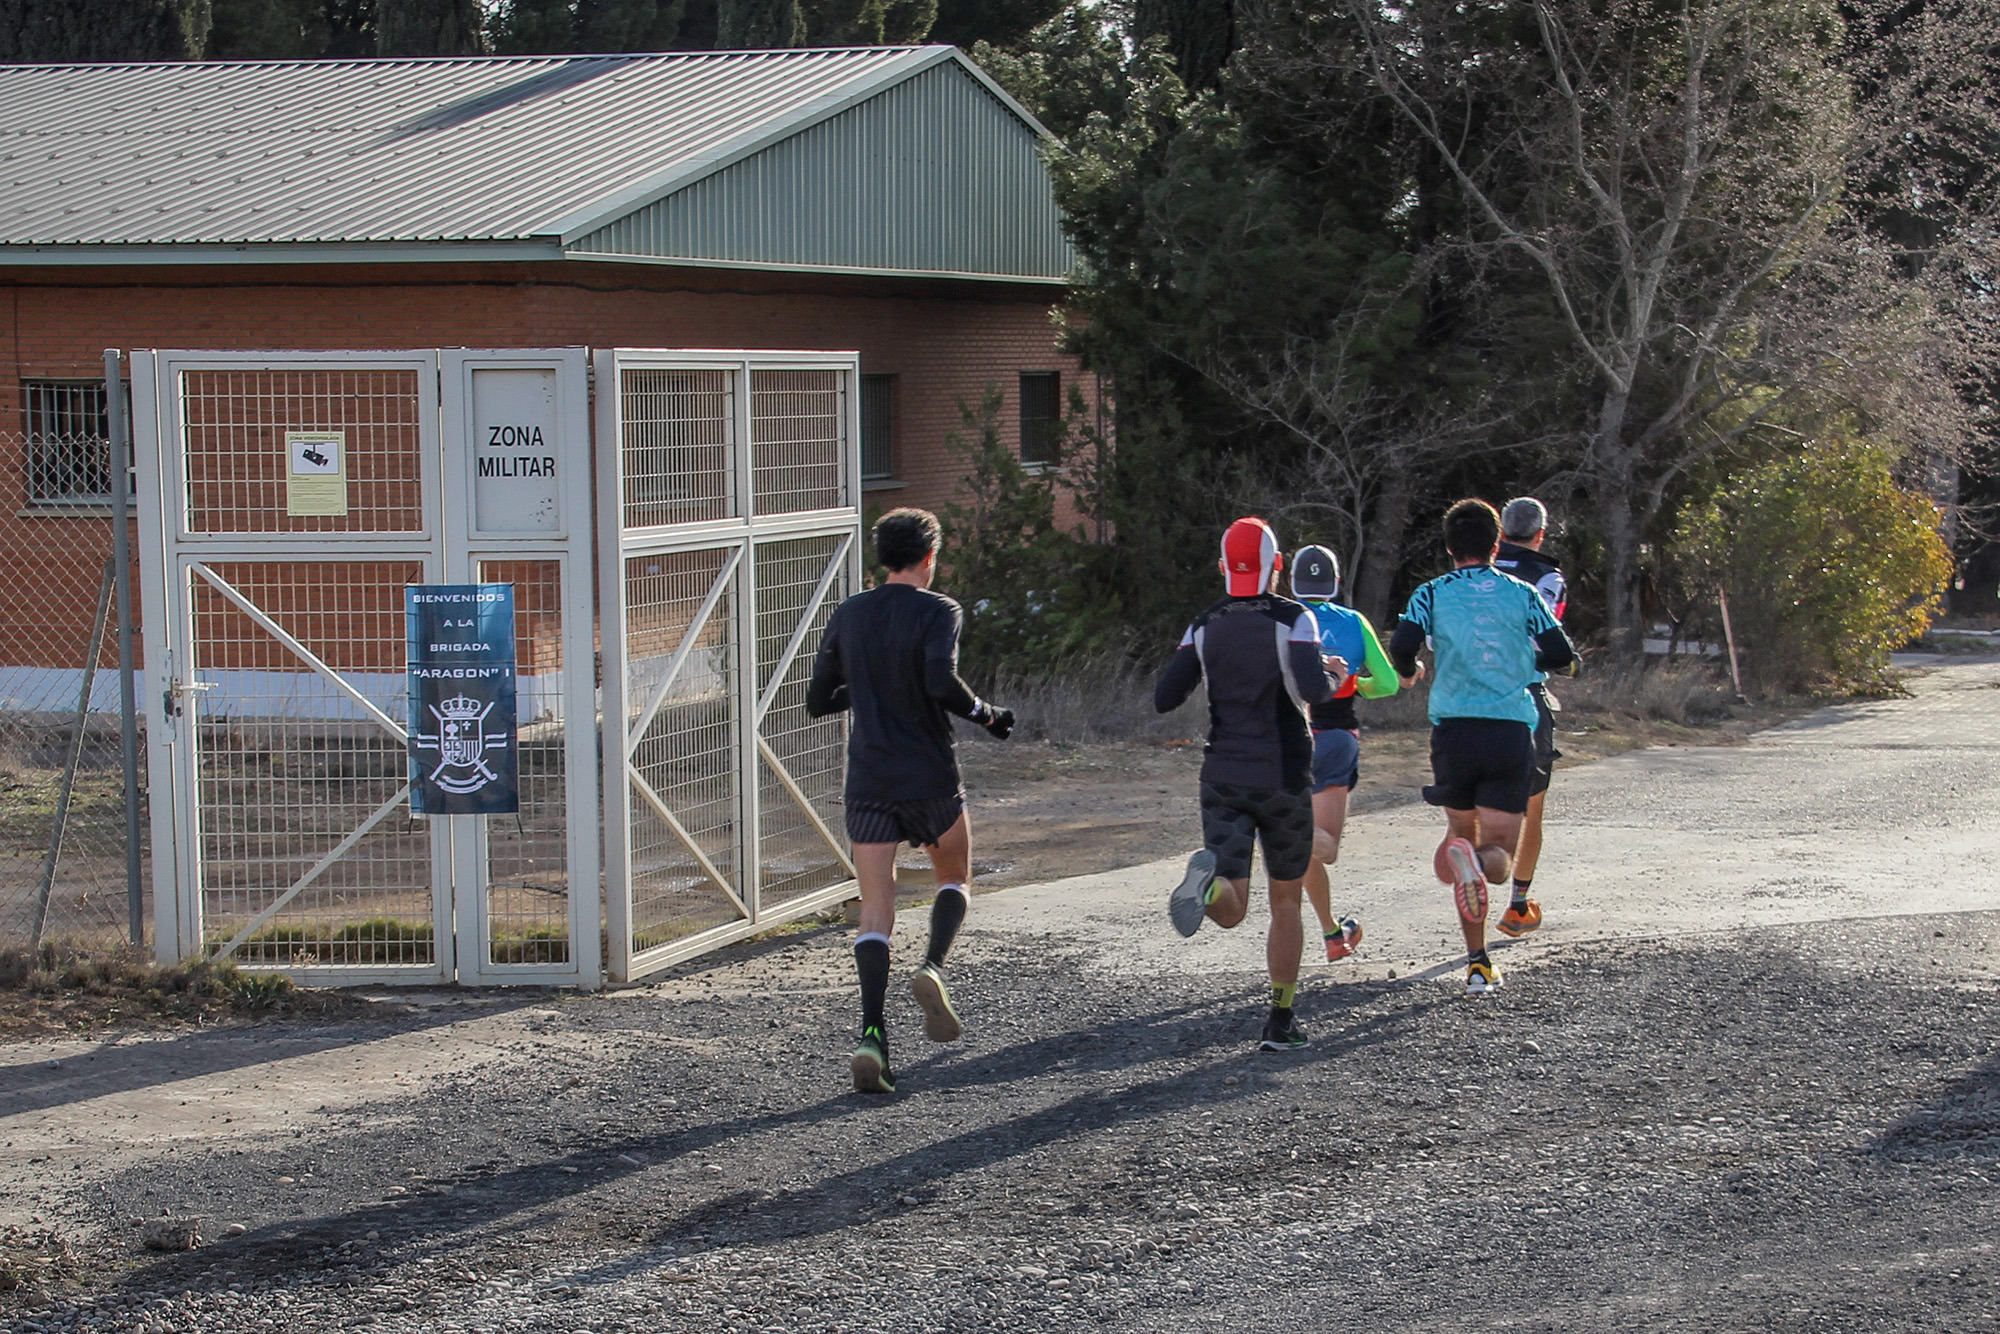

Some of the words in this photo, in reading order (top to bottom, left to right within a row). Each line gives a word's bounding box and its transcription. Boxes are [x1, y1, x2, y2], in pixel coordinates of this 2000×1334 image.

[488, 426, 544, 447] ZONA
[478, 456, 555, 478] MILITAR
[413, 594, 505, 603] BIENVENIDOS
[443, 619, 453, 627] A
[457, 619, 475, 627] LA
[429, 643, 491, 652] BRIGADA
